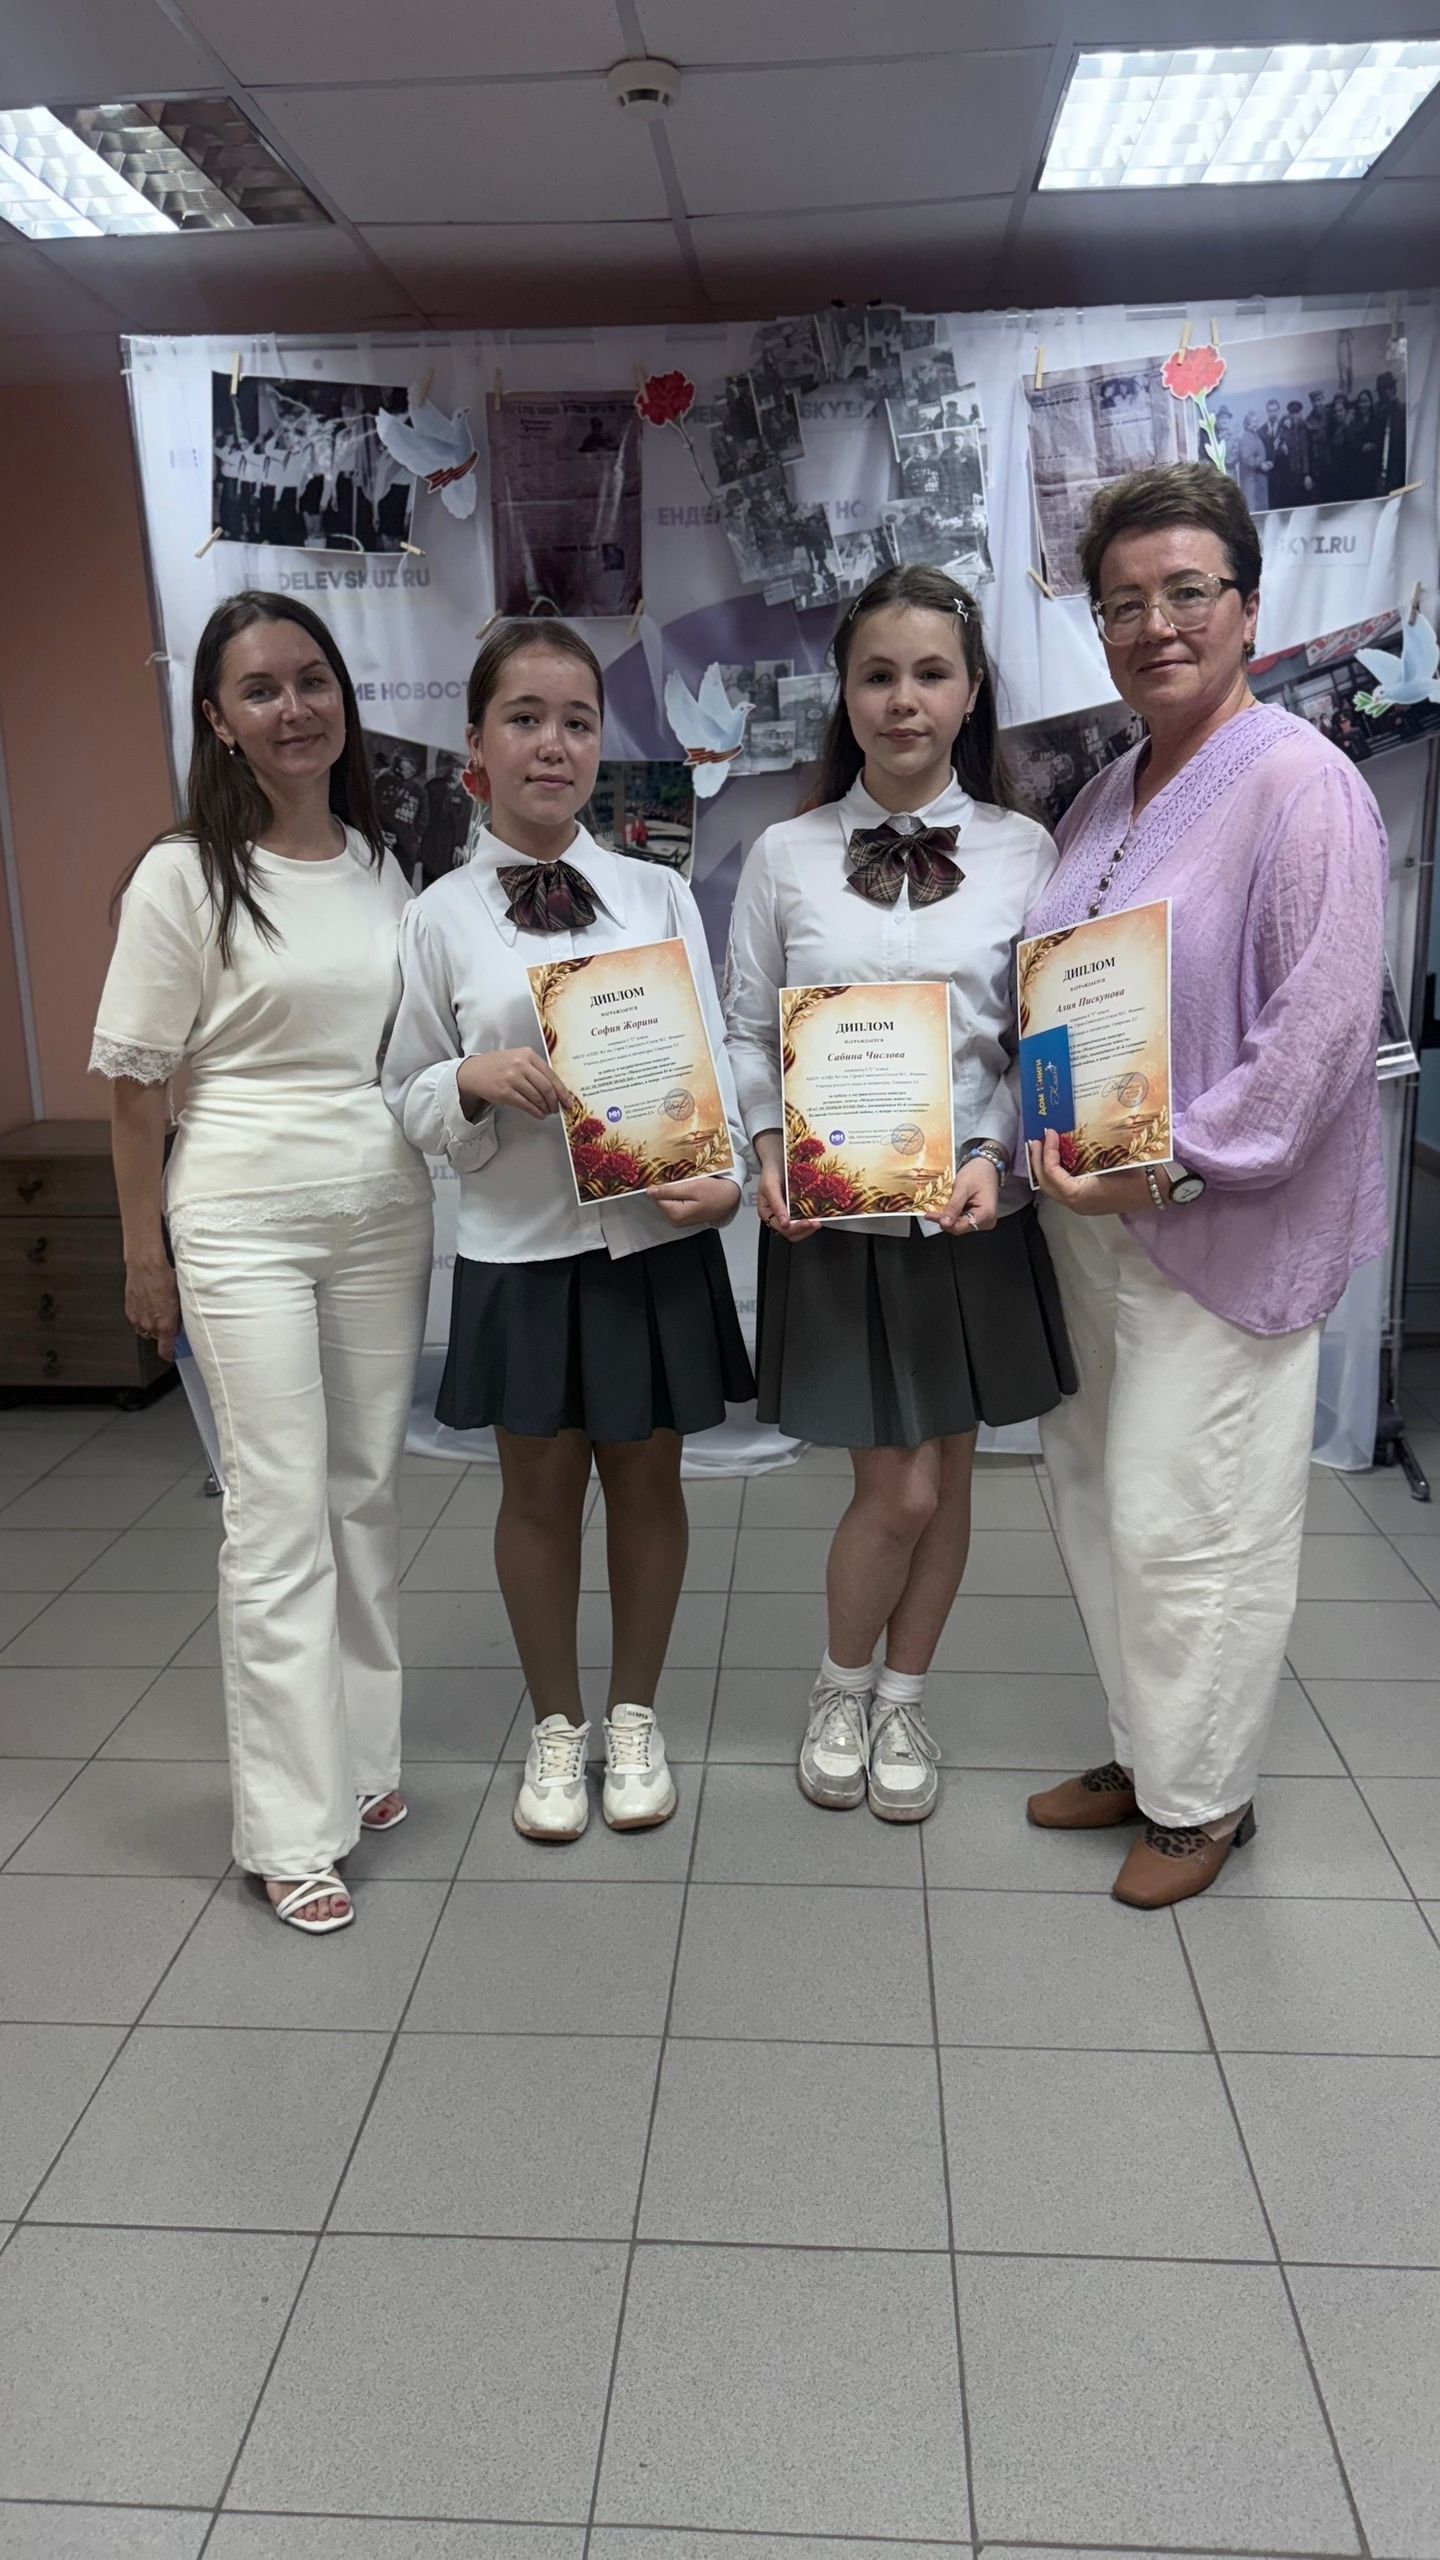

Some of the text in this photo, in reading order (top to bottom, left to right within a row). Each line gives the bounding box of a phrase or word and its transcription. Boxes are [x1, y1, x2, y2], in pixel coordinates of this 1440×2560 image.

[1062, 957, 1116, 983] ДИПЛОМ
[590, 986, 645, 1008] ДИПЛОМ
[590, 1017, 659, 1037] София Жорина
[835, 1021, 895, 1034] ДИПЛОМ
[827, 1050, 906, 1062] Сабина Числова
